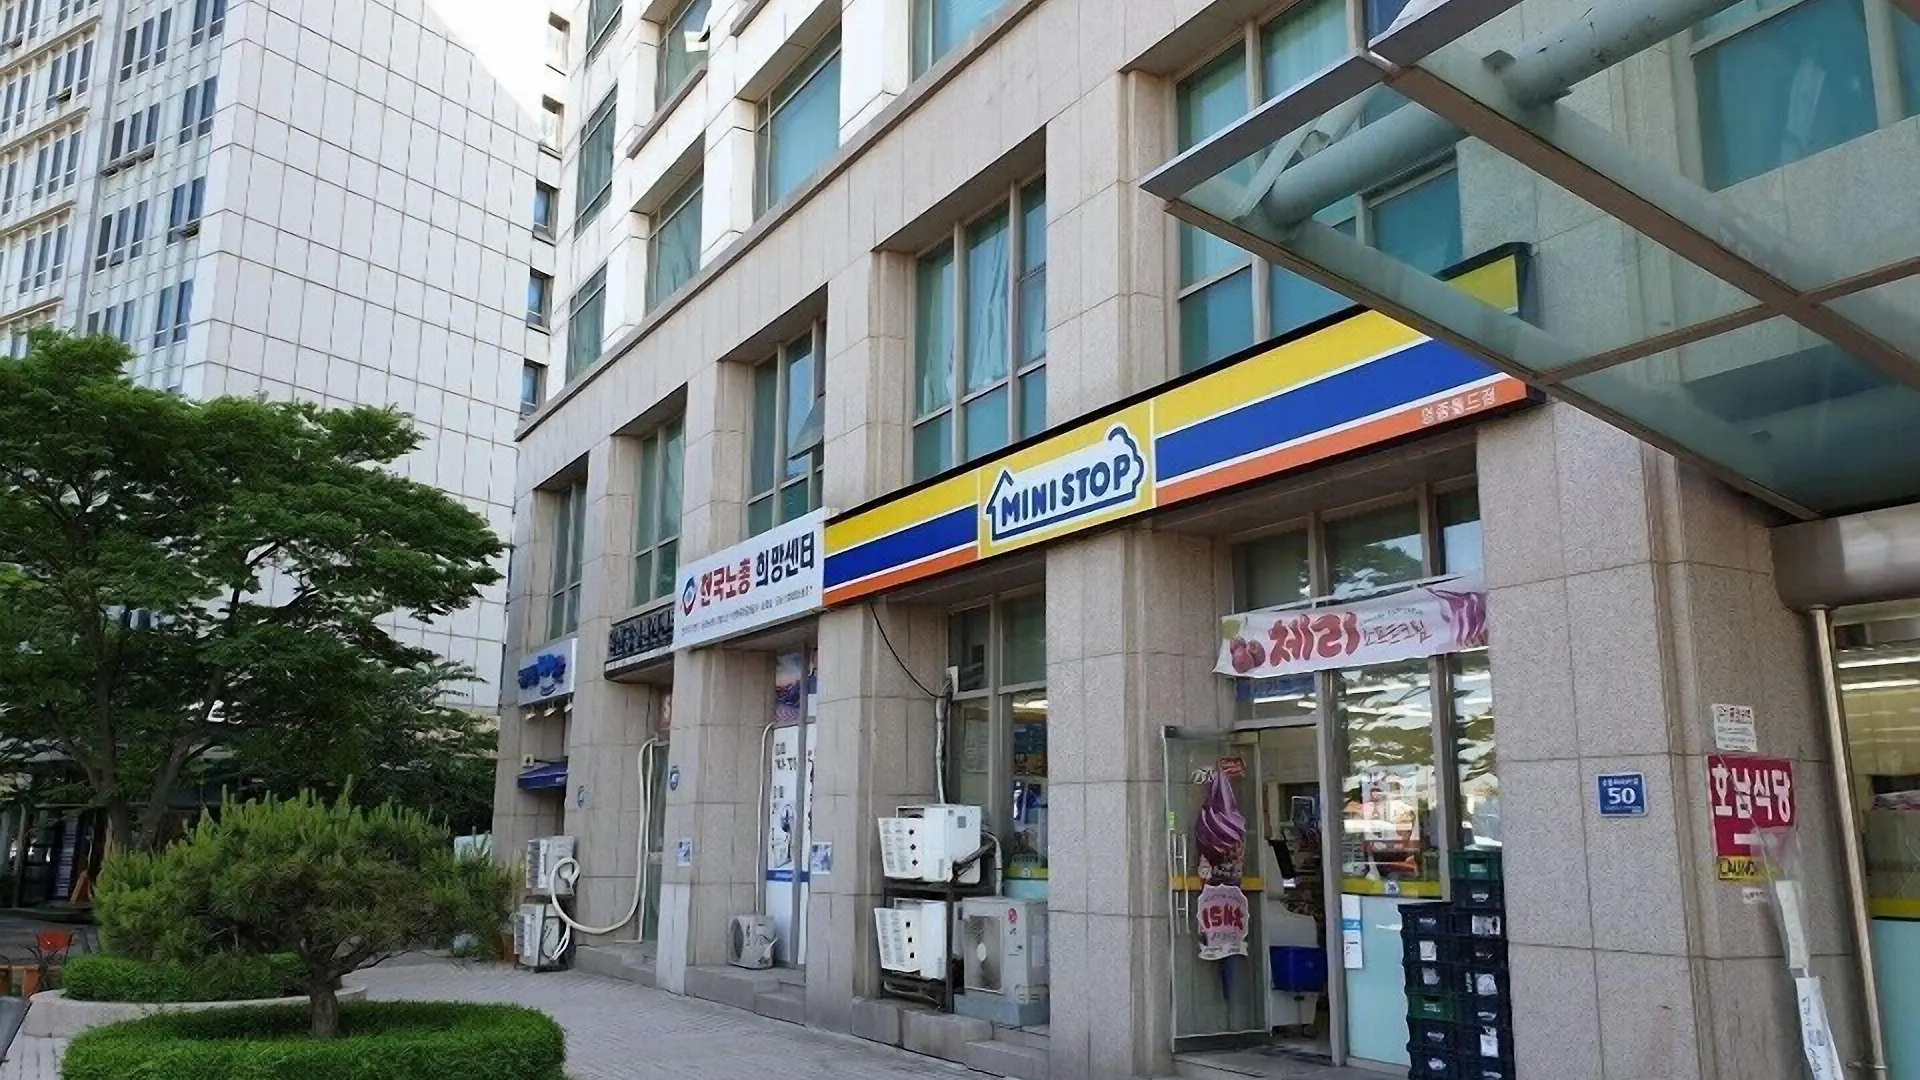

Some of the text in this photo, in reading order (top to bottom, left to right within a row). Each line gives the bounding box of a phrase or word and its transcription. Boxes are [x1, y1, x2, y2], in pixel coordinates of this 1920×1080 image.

[1001, 454, 1131, 527] MINISTOP
[755, 531, 815, 588] 희망센터
[1267, 611, 1361, 667] 체리
[1608, 787, 1636, 805] 50
[1711, 763, 1791, 823] 호남식당
